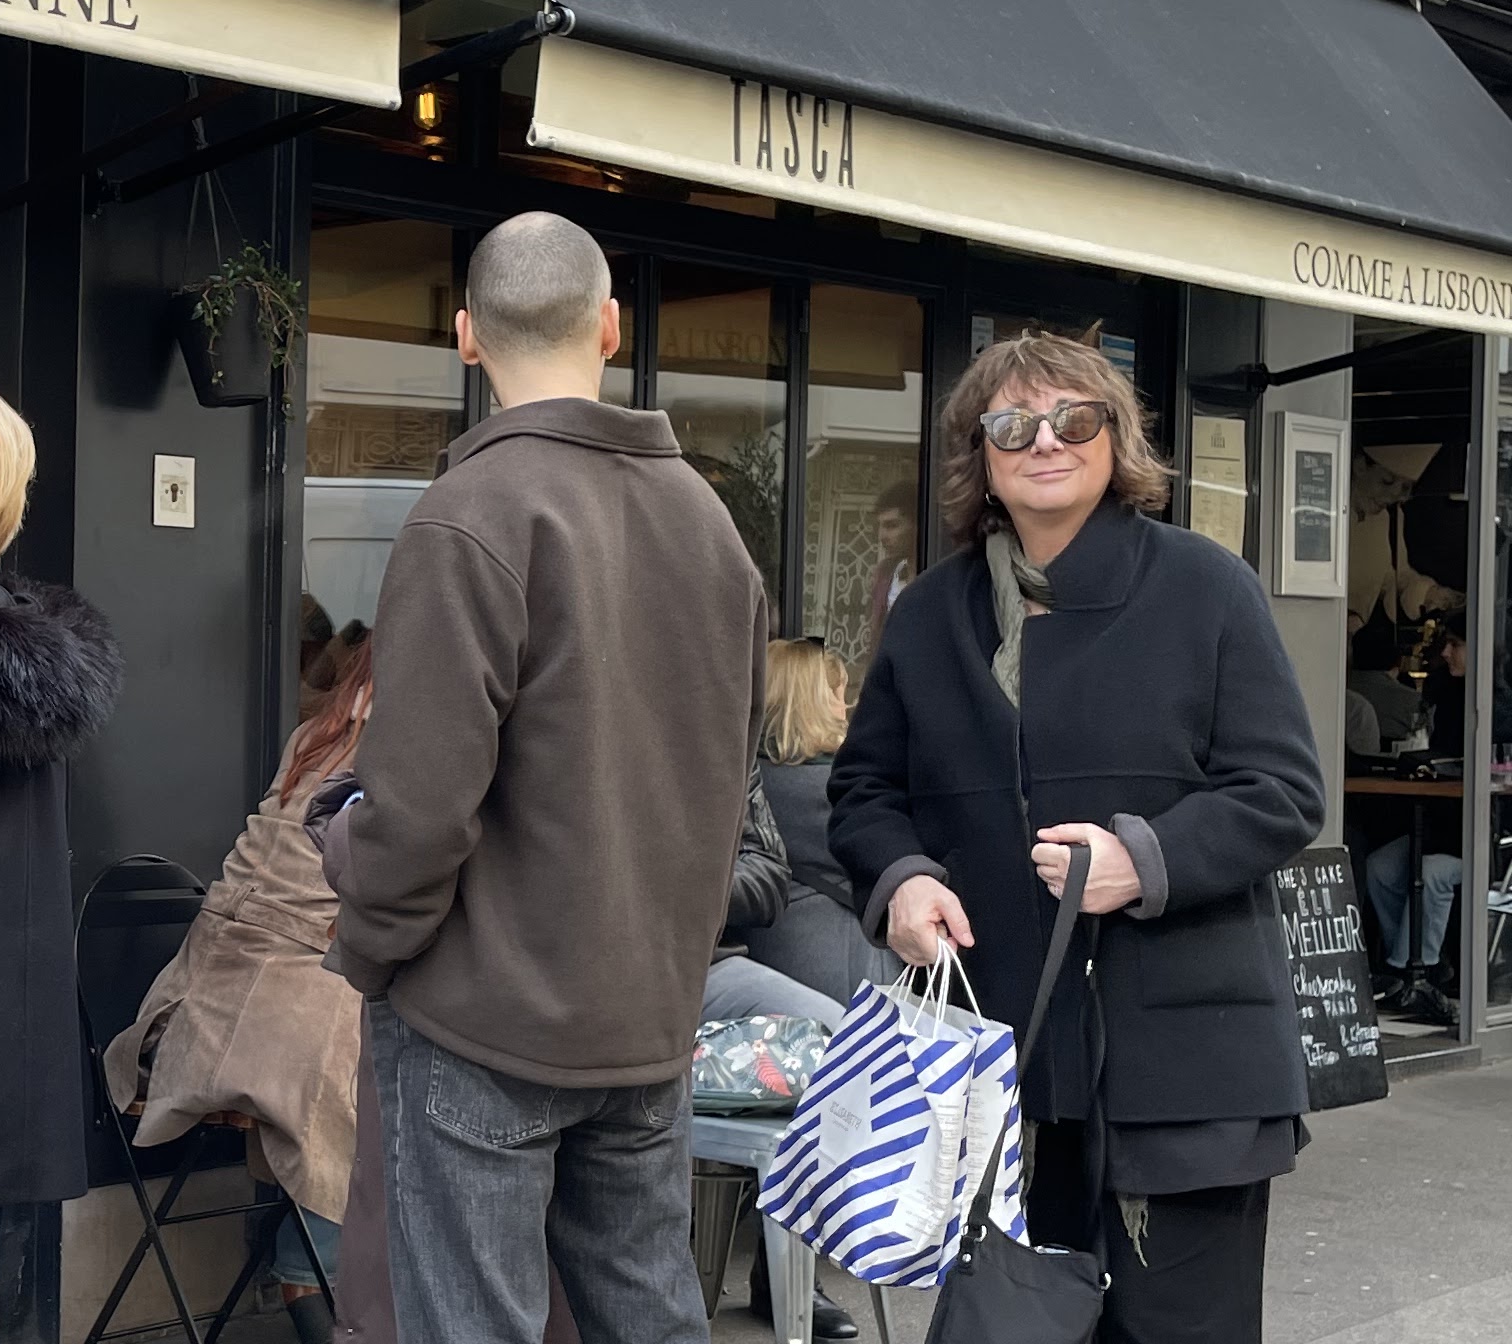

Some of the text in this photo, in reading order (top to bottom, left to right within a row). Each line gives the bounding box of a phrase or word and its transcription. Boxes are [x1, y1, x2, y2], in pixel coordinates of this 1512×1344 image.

[730, 77, 855, 189] TASCA
[1293, 242, 1393, 301] COMME
[1398, 264, 1416, 305] A
[1276, 864, 1344, 888] SHE'S CAKE
